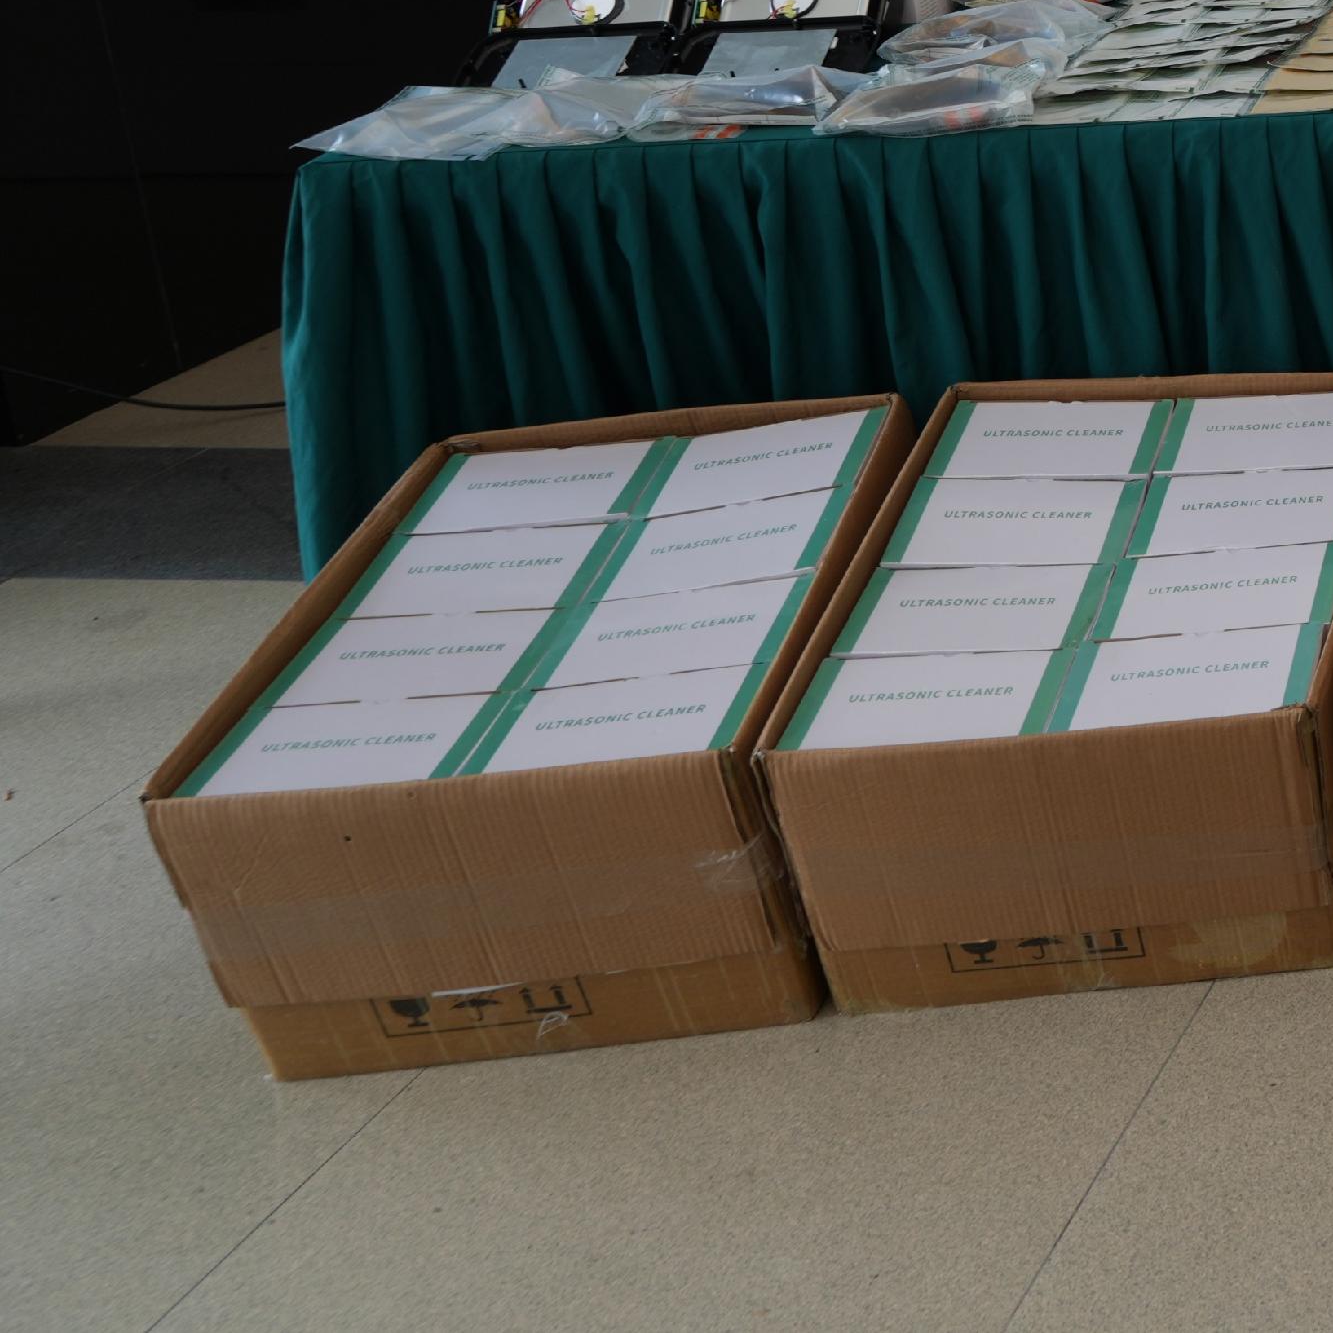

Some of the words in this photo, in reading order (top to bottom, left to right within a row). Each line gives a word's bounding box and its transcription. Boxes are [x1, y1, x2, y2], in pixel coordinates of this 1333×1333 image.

[983, 428, 1064, 437] ULTRASONIC
[1065, 427, 1124, 437] CLEANER
[1205, 421, 1283, 433] ULTRASONIC
[693, 450, 773, 471] ULTRASONIC
[775, 441, 833, 457] CLEANER
[466, 476, 552, 490] ULTRASONIC
[553, 470, 615, 484] CLEANER
[1181, 499, 1261, 511] ULTRASONIC
[1265, 494, 1324, 507] CLEANER
[943, 509, 1028, 520] ULTRASONIC
[1031, 510, 1093, 519] CLEANER
[650, 534, 735, 555] ULTRASONIC
[736, 523, 798, 541] CLEANER
[407, 561, 497, 575] ULTRASONIC
[498, 556, 564, 569] CLEANER
[1148, 580, 1234, 595] ULTRASONIC
[1237, 575, 1298, 587] CLEANER
[899, 597, 989, 608] ULTRASONIC
[991, 597, 1057, 606] CLEANER
[597, 622, 688, 642] ULTRASONIC
[690, 613, 757, 630] CLEANER
[338, 646, 435, 661] ULTRASONIC
[437, 642, 507, 655] CLEANER
[1110, 665, 1201, 682] ULTRASONIC
[1204, 659, 1270, 674] CLEANER
[848, 689, 942, 704] ULTRASONIC
[945, 685, 1014, 698] CLEANER
[535, 712, 633, 731] ULTRASONIC
[636, 703, 707, 720] CLEANER
[261, 737, 361, 753] ULTRASONIC
[363, 732, 437, 746] CLEANER
